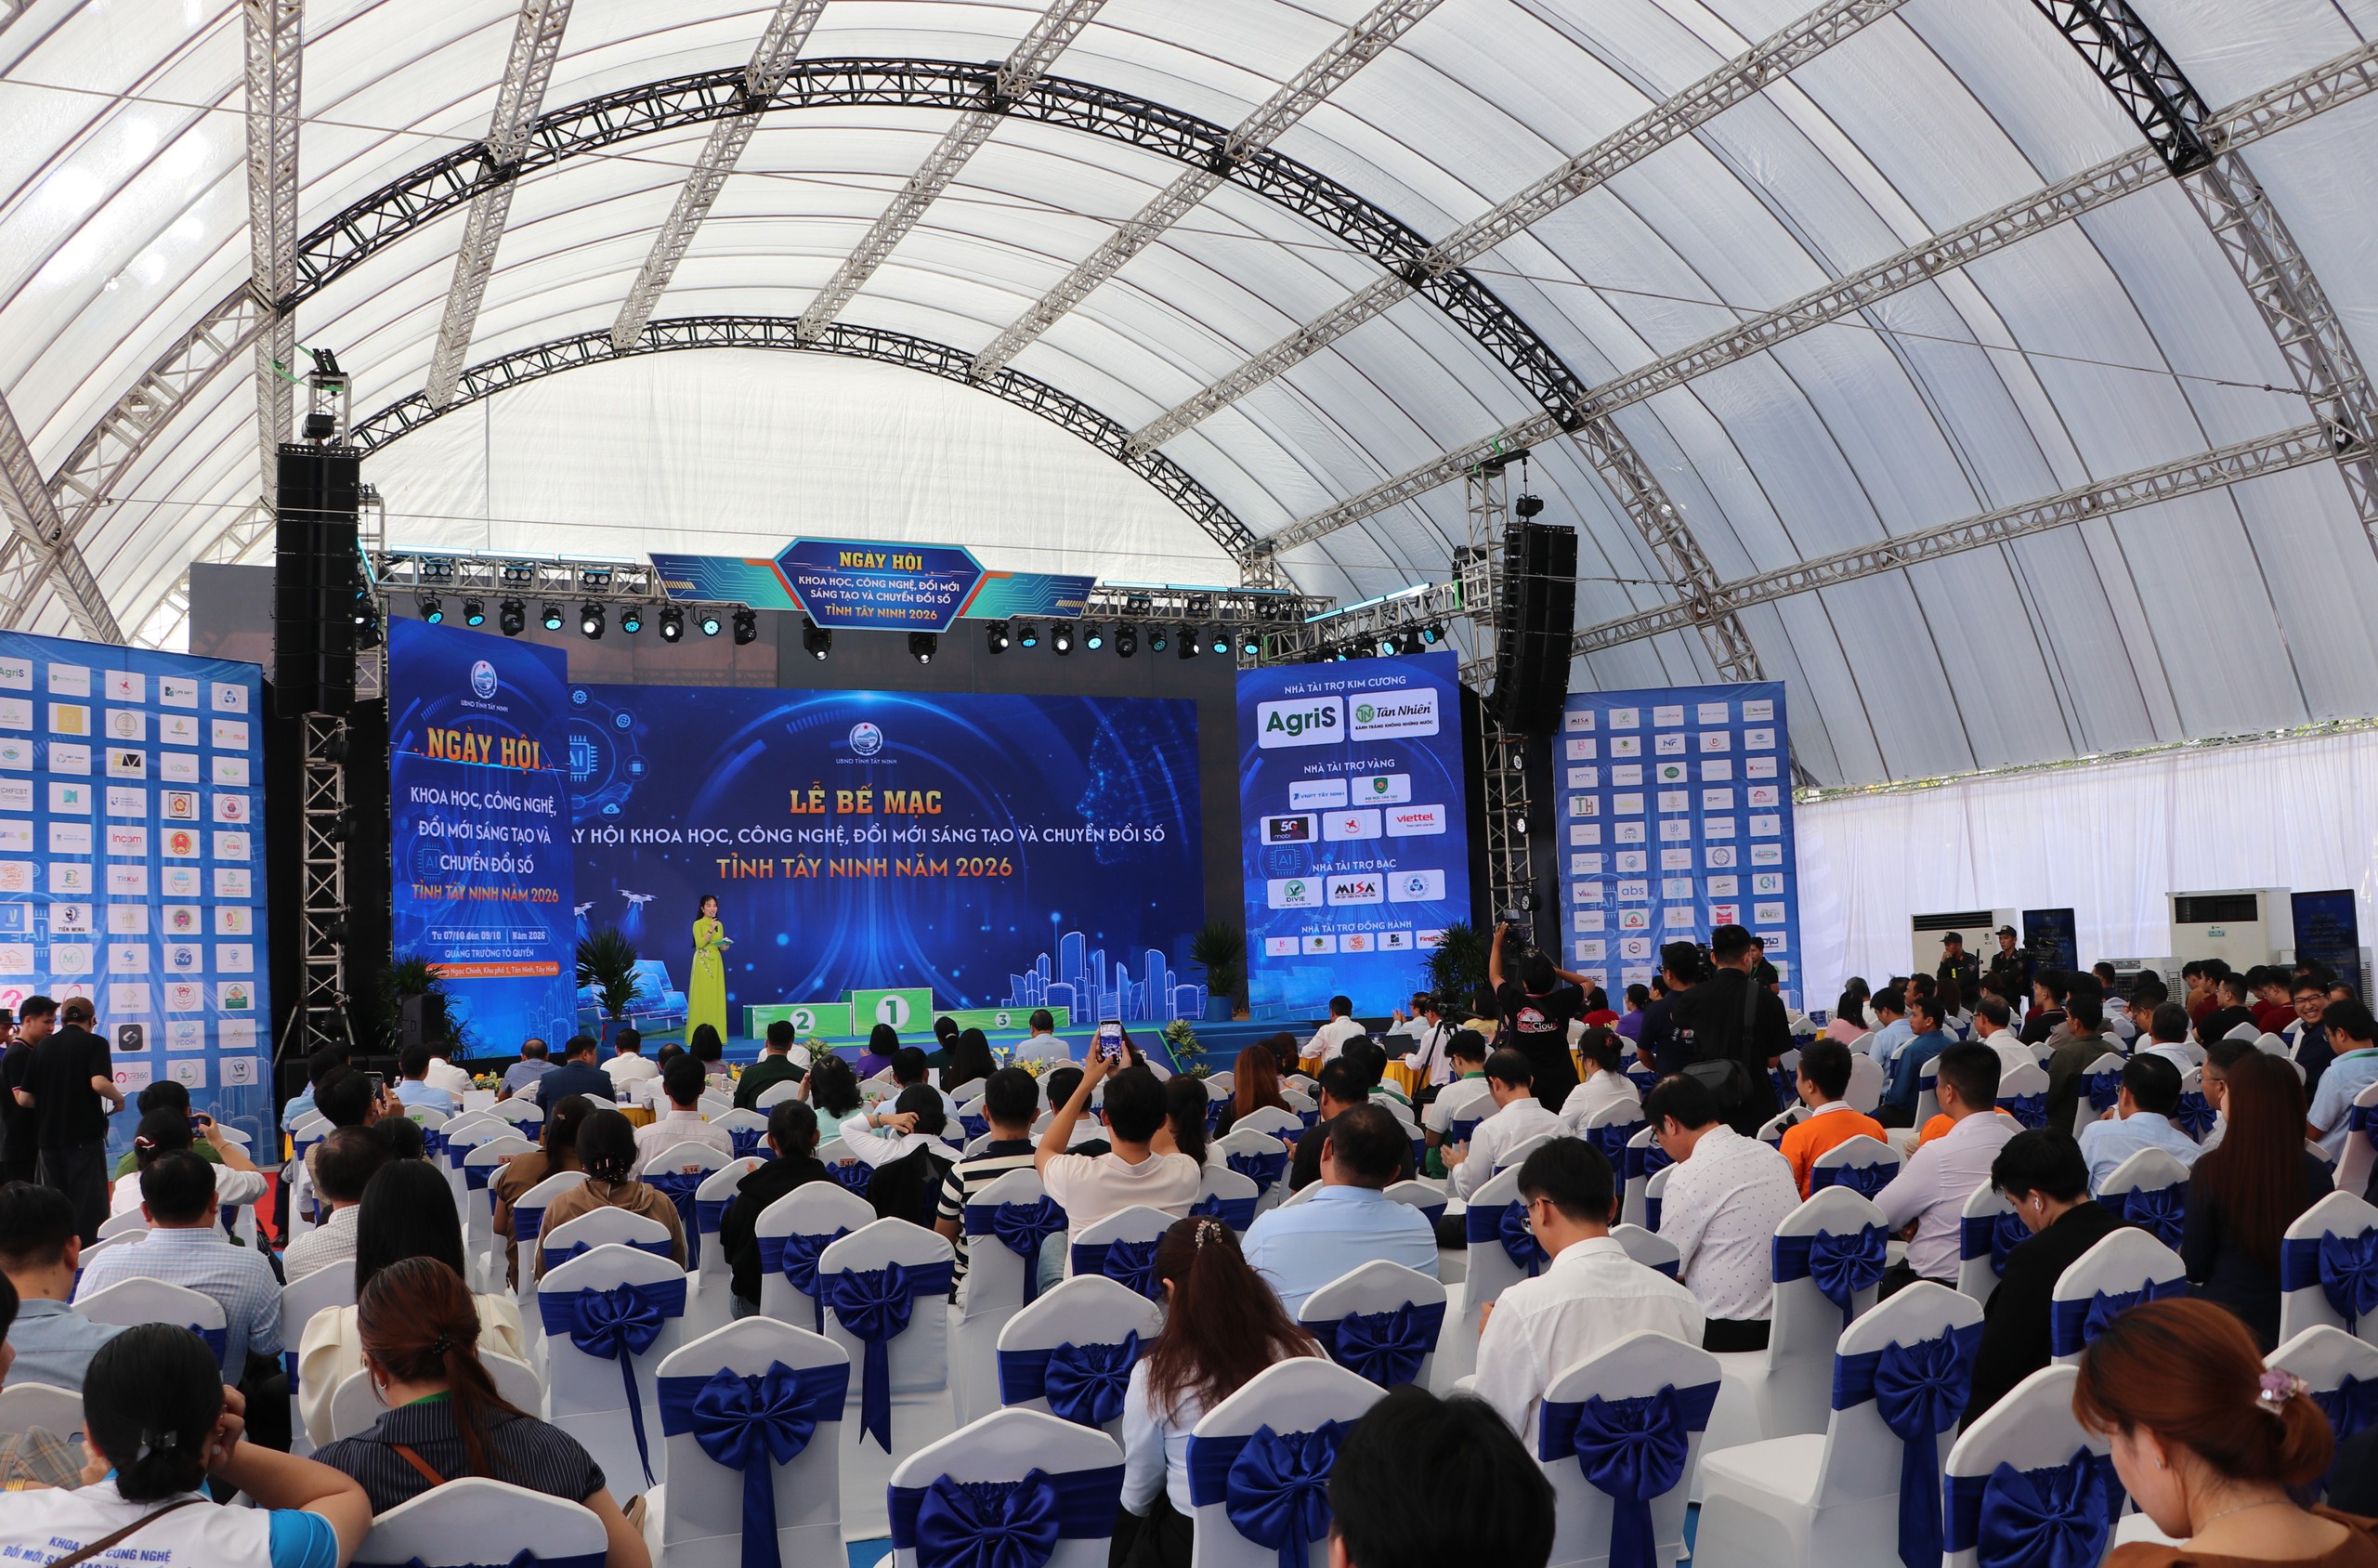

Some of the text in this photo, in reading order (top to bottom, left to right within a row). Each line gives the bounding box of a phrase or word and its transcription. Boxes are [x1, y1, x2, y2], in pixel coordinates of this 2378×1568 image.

[840, 550, 922, 573] NGÀY HỘI
[799, 576, 960, 592] KHOA HỌC, CÔNG NGHỆ, ĐỔI MỚI
[810, 588, 951, 604] SÁNG TẠO VÀ CHUYỂN ĐỔI SỐ
[825, 604, 937, 621] TỈNH TÂY NINH 2026
[1285, 676, 1406, 695] NHÀ TÀI TRỢ KIM CƯƠNG
[461, 700, 475, 709] UBND
[1377, 706, 1396, 718] Tân
[1398, 704, 1431, 717] Nhiên
[1265, 706, 1337, 737] AgriS
[427, 725, 541, 776] NGÀY HỘI
[1304, 758, 1395, 774] NHÀ TÀI TRỢ VÀNG
[411, 786, 557, 818] KHOA HỌC, CÔNG NGHỆ,
[790, 780, 942, 819] LỄ BẾ MẠC
[1397, 813, 1434, 823] viettel
[419, 816, 552, 847] ĐỔI MỚI SÁNG TẠO VÀ
[591, 825, 625, 847] HỘI
[631, 829, 683, 844] KHOA
[688, 829, 733, 847] HỌC,
[738, 824, 792, 843] CÔNG
[798, 825, 850, 847] NGHỆ,
[854, 823, 887, 843] ĐỔI
[893, 825, 926, 843] MỚI
[931, 825, 976, 843] SÁNG
[981, 829, 1014, 846] TẠO
[1018, 825, 1039, 843] VÀ
[1043, 822, 1104, 843] CHUYỂN
[1109, 822, 1140, 843] ĐỔI
[1144, 823, 1165, 843] SỐ
[440, 850, 534, 874] CHUYỂN ĐỔI SỐ
[716, 853, 1013, 879] TỈNH TÂY NINH NĂM 2026
[1313, 859, 1397, 872] NHÀ TÀI TRỢ BẠC
[412, 879, 559, 903] TỈNH TÂY NINH NĂM 2026
[1335, 881, 1375, 895] MISA
[1622, 886, 1644, 896] abs
[1302, 919, 1412, 934] NHÀ TÀI TRỢ ĐỒNG HÀNH
[444, 931, 465, 941] 07/10
[481, 931, 502, 941] 09/10
[513, 931, 528, 940] Năm
[529, 931, 546, 940] 2026
[472, 947, 501, 958] TRƯỜNG
[886, 1000, 899, 1024] 1
[796, 1013, 810, 1029] 2
[999, 1015, 1008, 1026] 3
[1518, 1022, 1558, 1031] RedClou
[3, 1544, 21, 1558] ĐỔI
[22, 1550, 45, 1563] MỚI
[49, 1536, 79, 1551] KHOA
[140, 1549, 172, 1564] NGHỆ
